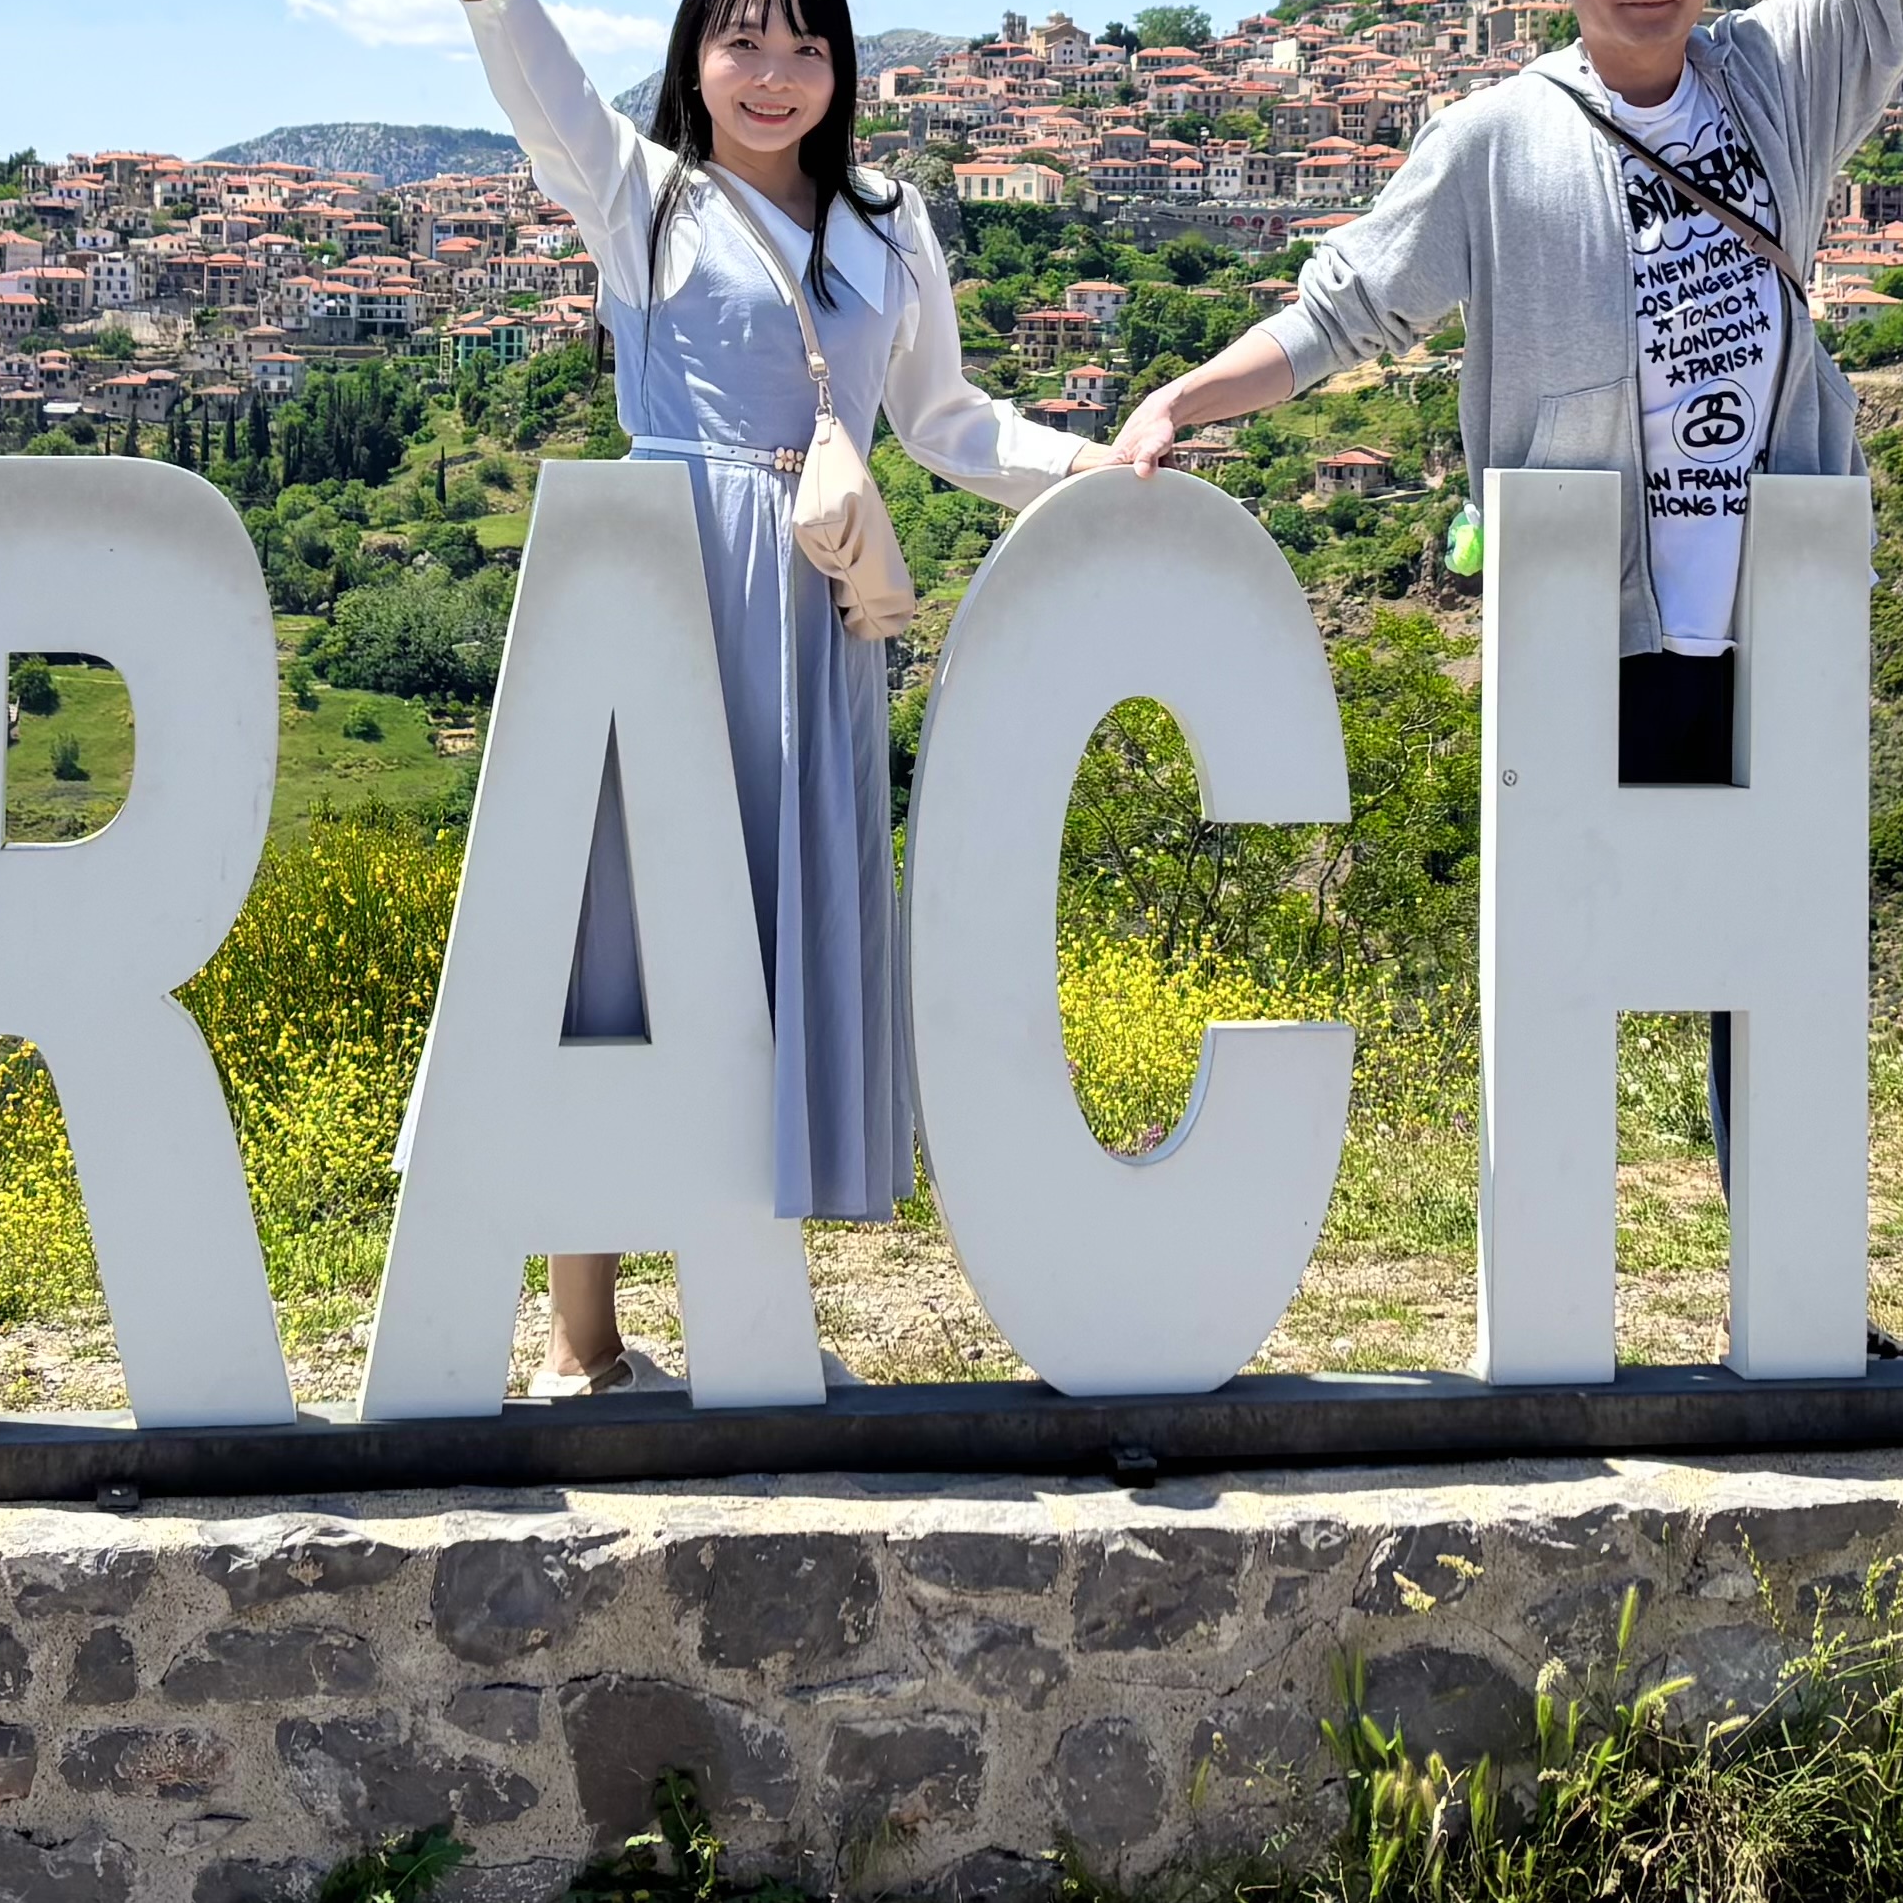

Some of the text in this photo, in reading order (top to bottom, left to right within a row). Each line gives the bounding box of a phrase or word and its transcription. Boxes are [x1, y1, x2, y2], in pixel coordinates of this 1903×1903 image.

[1647, 237, 1750, 288] NEW YORK
[1675, 294, 1742, 329] TOKYO
[1669, 314, 1755, 360] LONDON
[1684, 347, 1747, 383] PARIS
[1649, 493, 1717, 517] HONG
